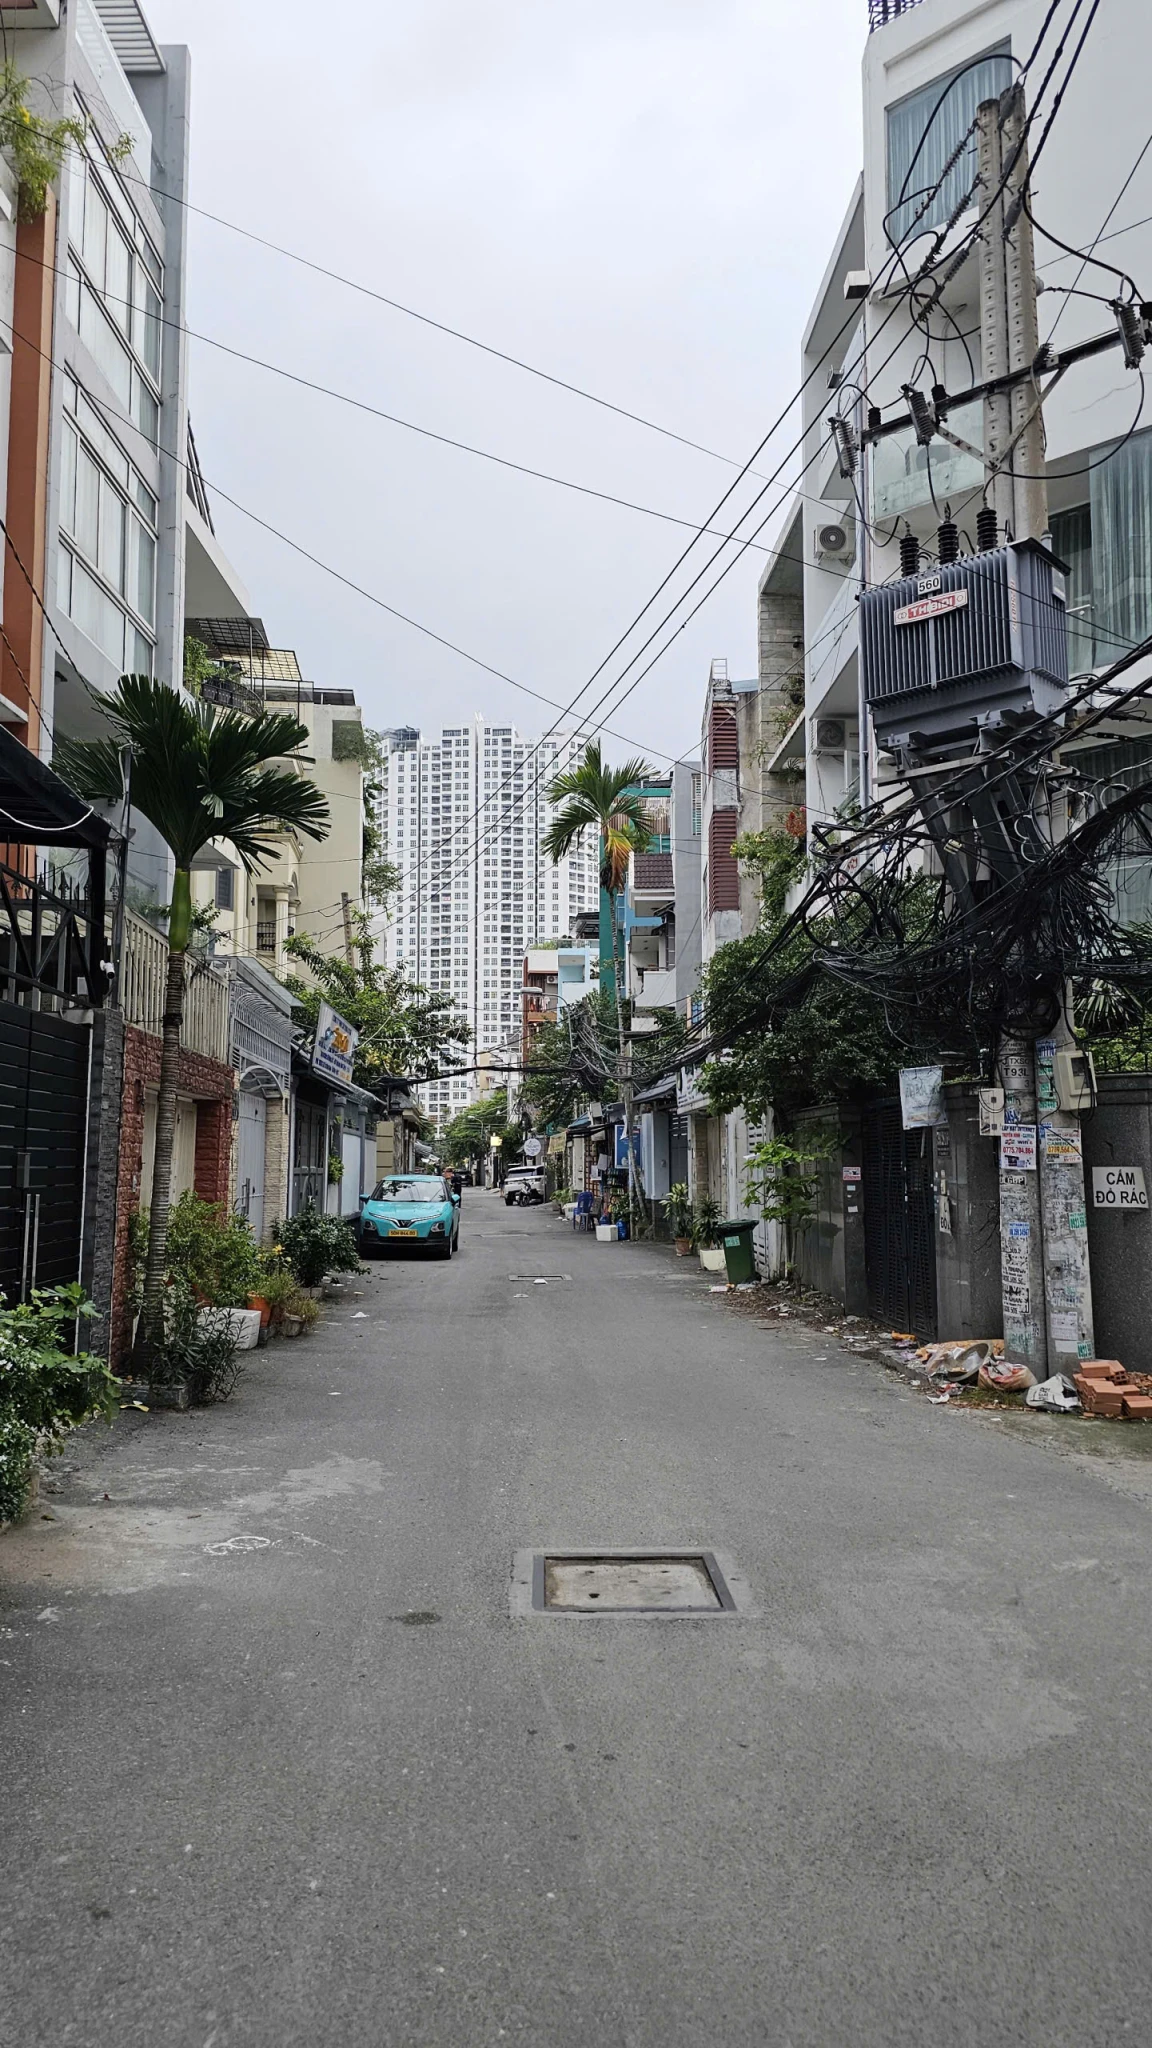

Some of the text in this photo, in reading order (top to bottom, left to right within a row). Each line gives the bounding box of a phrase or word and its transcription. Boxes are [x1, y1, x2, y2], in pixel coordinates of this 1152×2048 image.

[919, 577, 939, 592] 560
[1004, 1068, 1030, 1076] T93L
[1106, 1169, 1136, 1185] CẤM
[1095, 1188, 1147, 1204] ĐỔ RÁC
